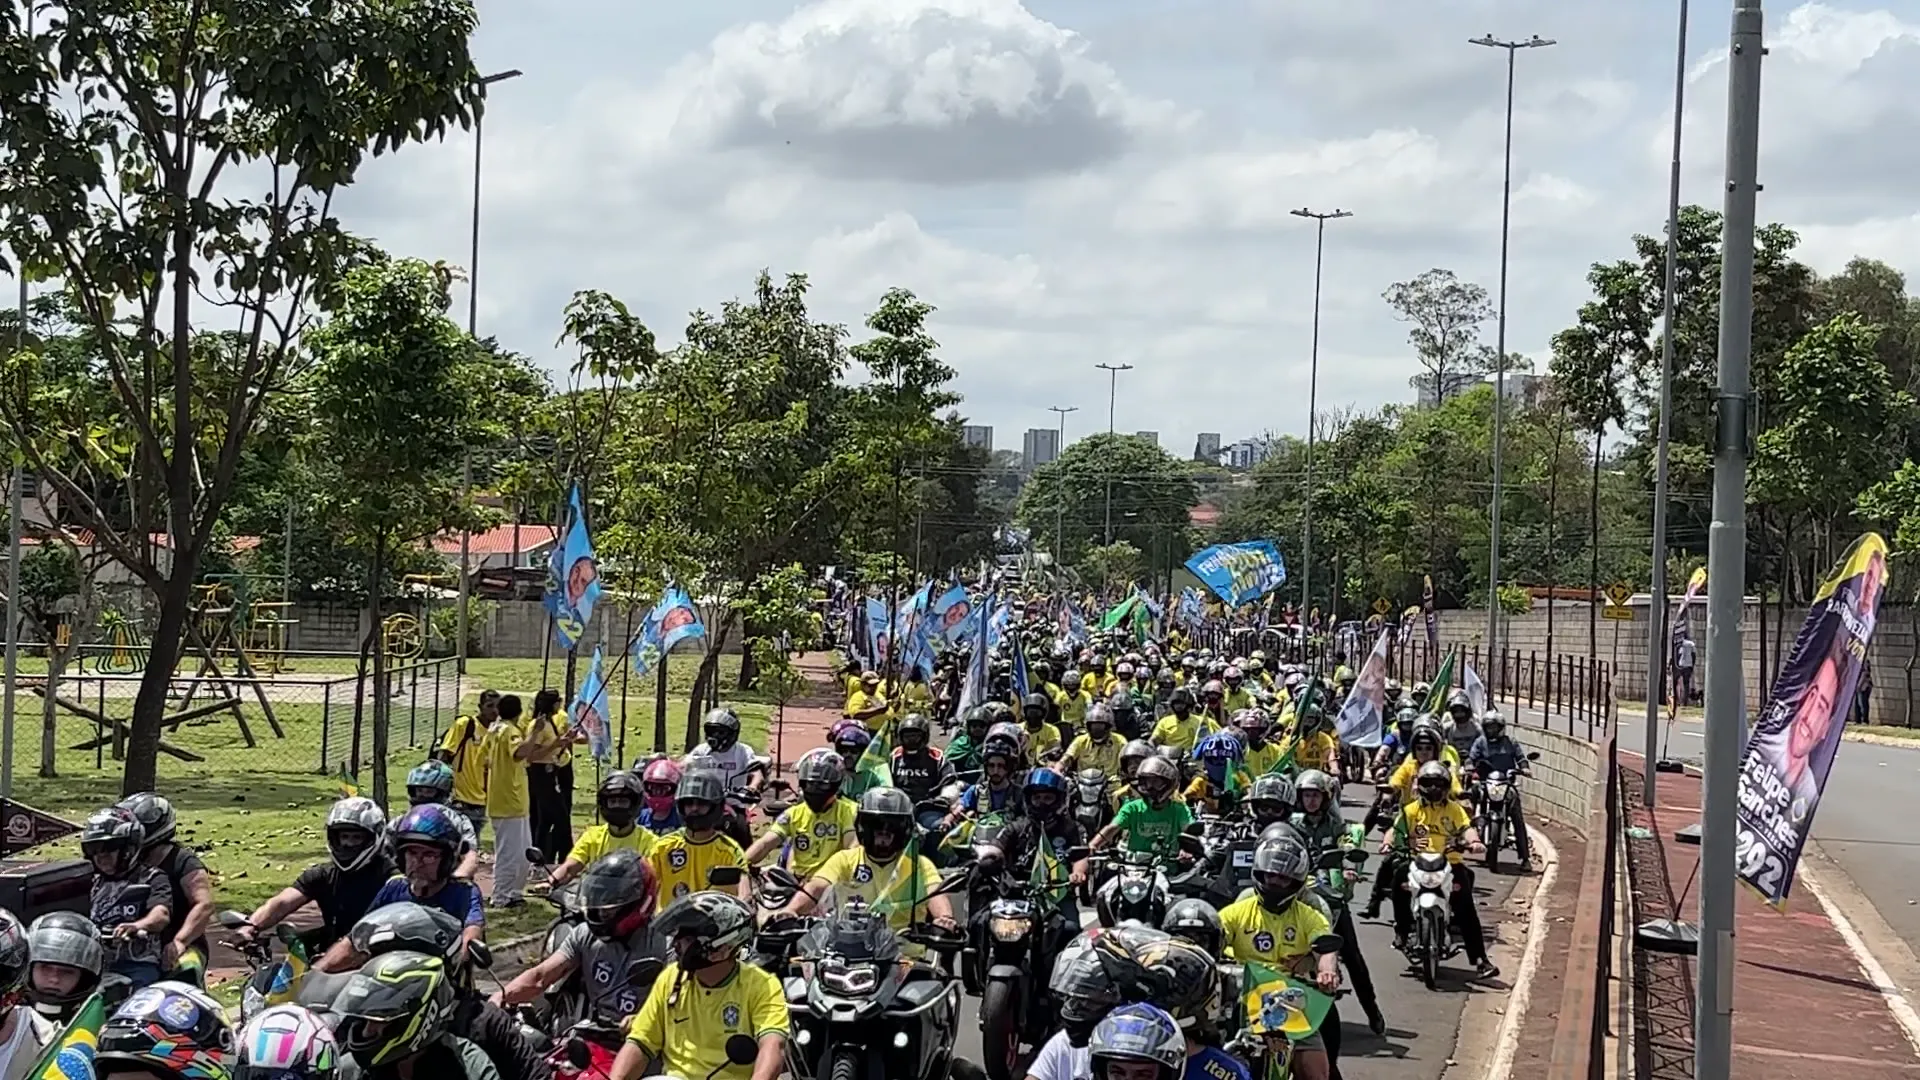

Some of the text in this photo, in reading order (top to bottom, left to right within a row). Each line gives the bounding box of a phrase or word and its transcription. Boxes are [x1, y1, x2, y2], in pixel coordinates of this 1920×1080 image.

[1744, 750, 1791, 808] Felipe
[1737, 773, 1799, 850] Sanches
[124, 905, 136, 916] 10
[1258, 940, 1272, 952] 10
[595, 968, 609, 983] 10
[620, 998, 635, 1012] 10
